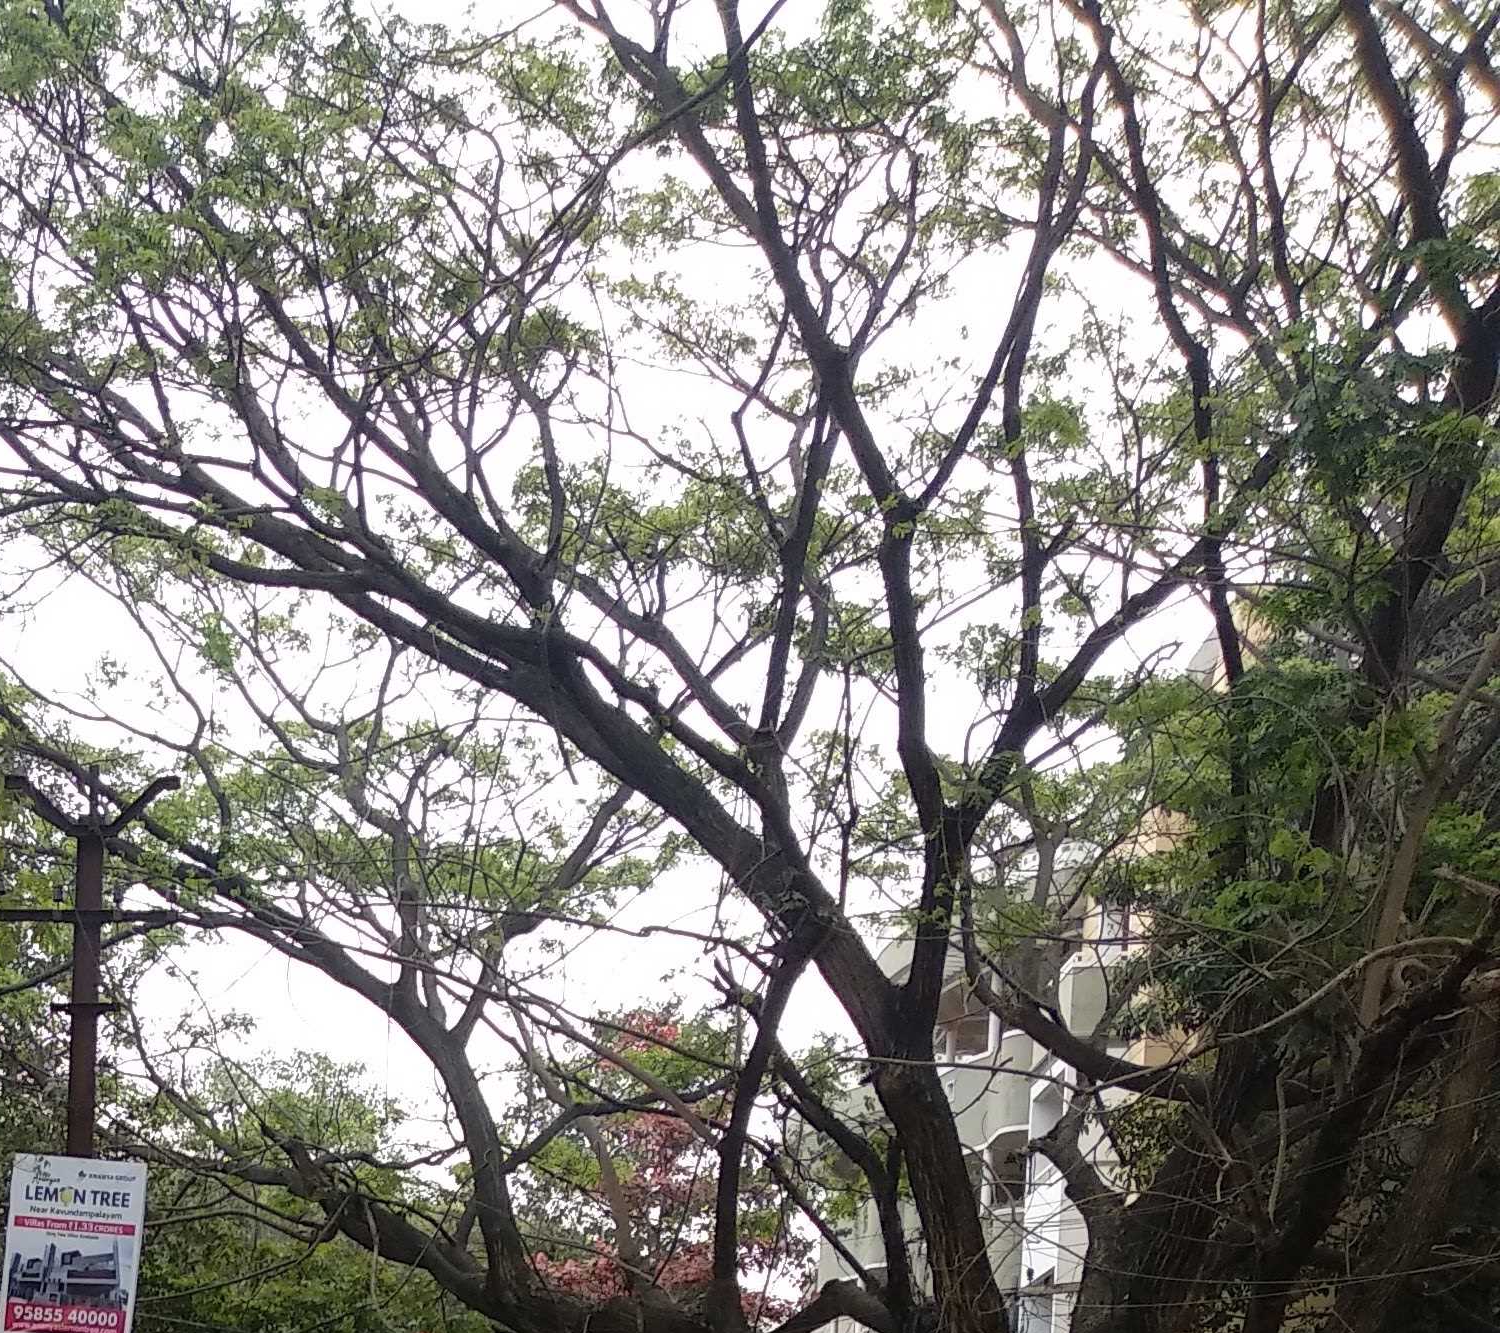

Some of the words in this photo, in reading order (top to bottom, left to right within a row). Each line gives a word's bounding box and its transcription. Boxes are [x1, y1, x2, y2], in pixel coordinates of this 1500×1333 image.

[25, 1185, 86, 1206] LEMON
[90, 1190, 130, 1208] TREE
[30, 1205, 48, 1213] Near
[13, 1305, 63, 1322] 95855
[67, 1309, 118, 1327] 40000
